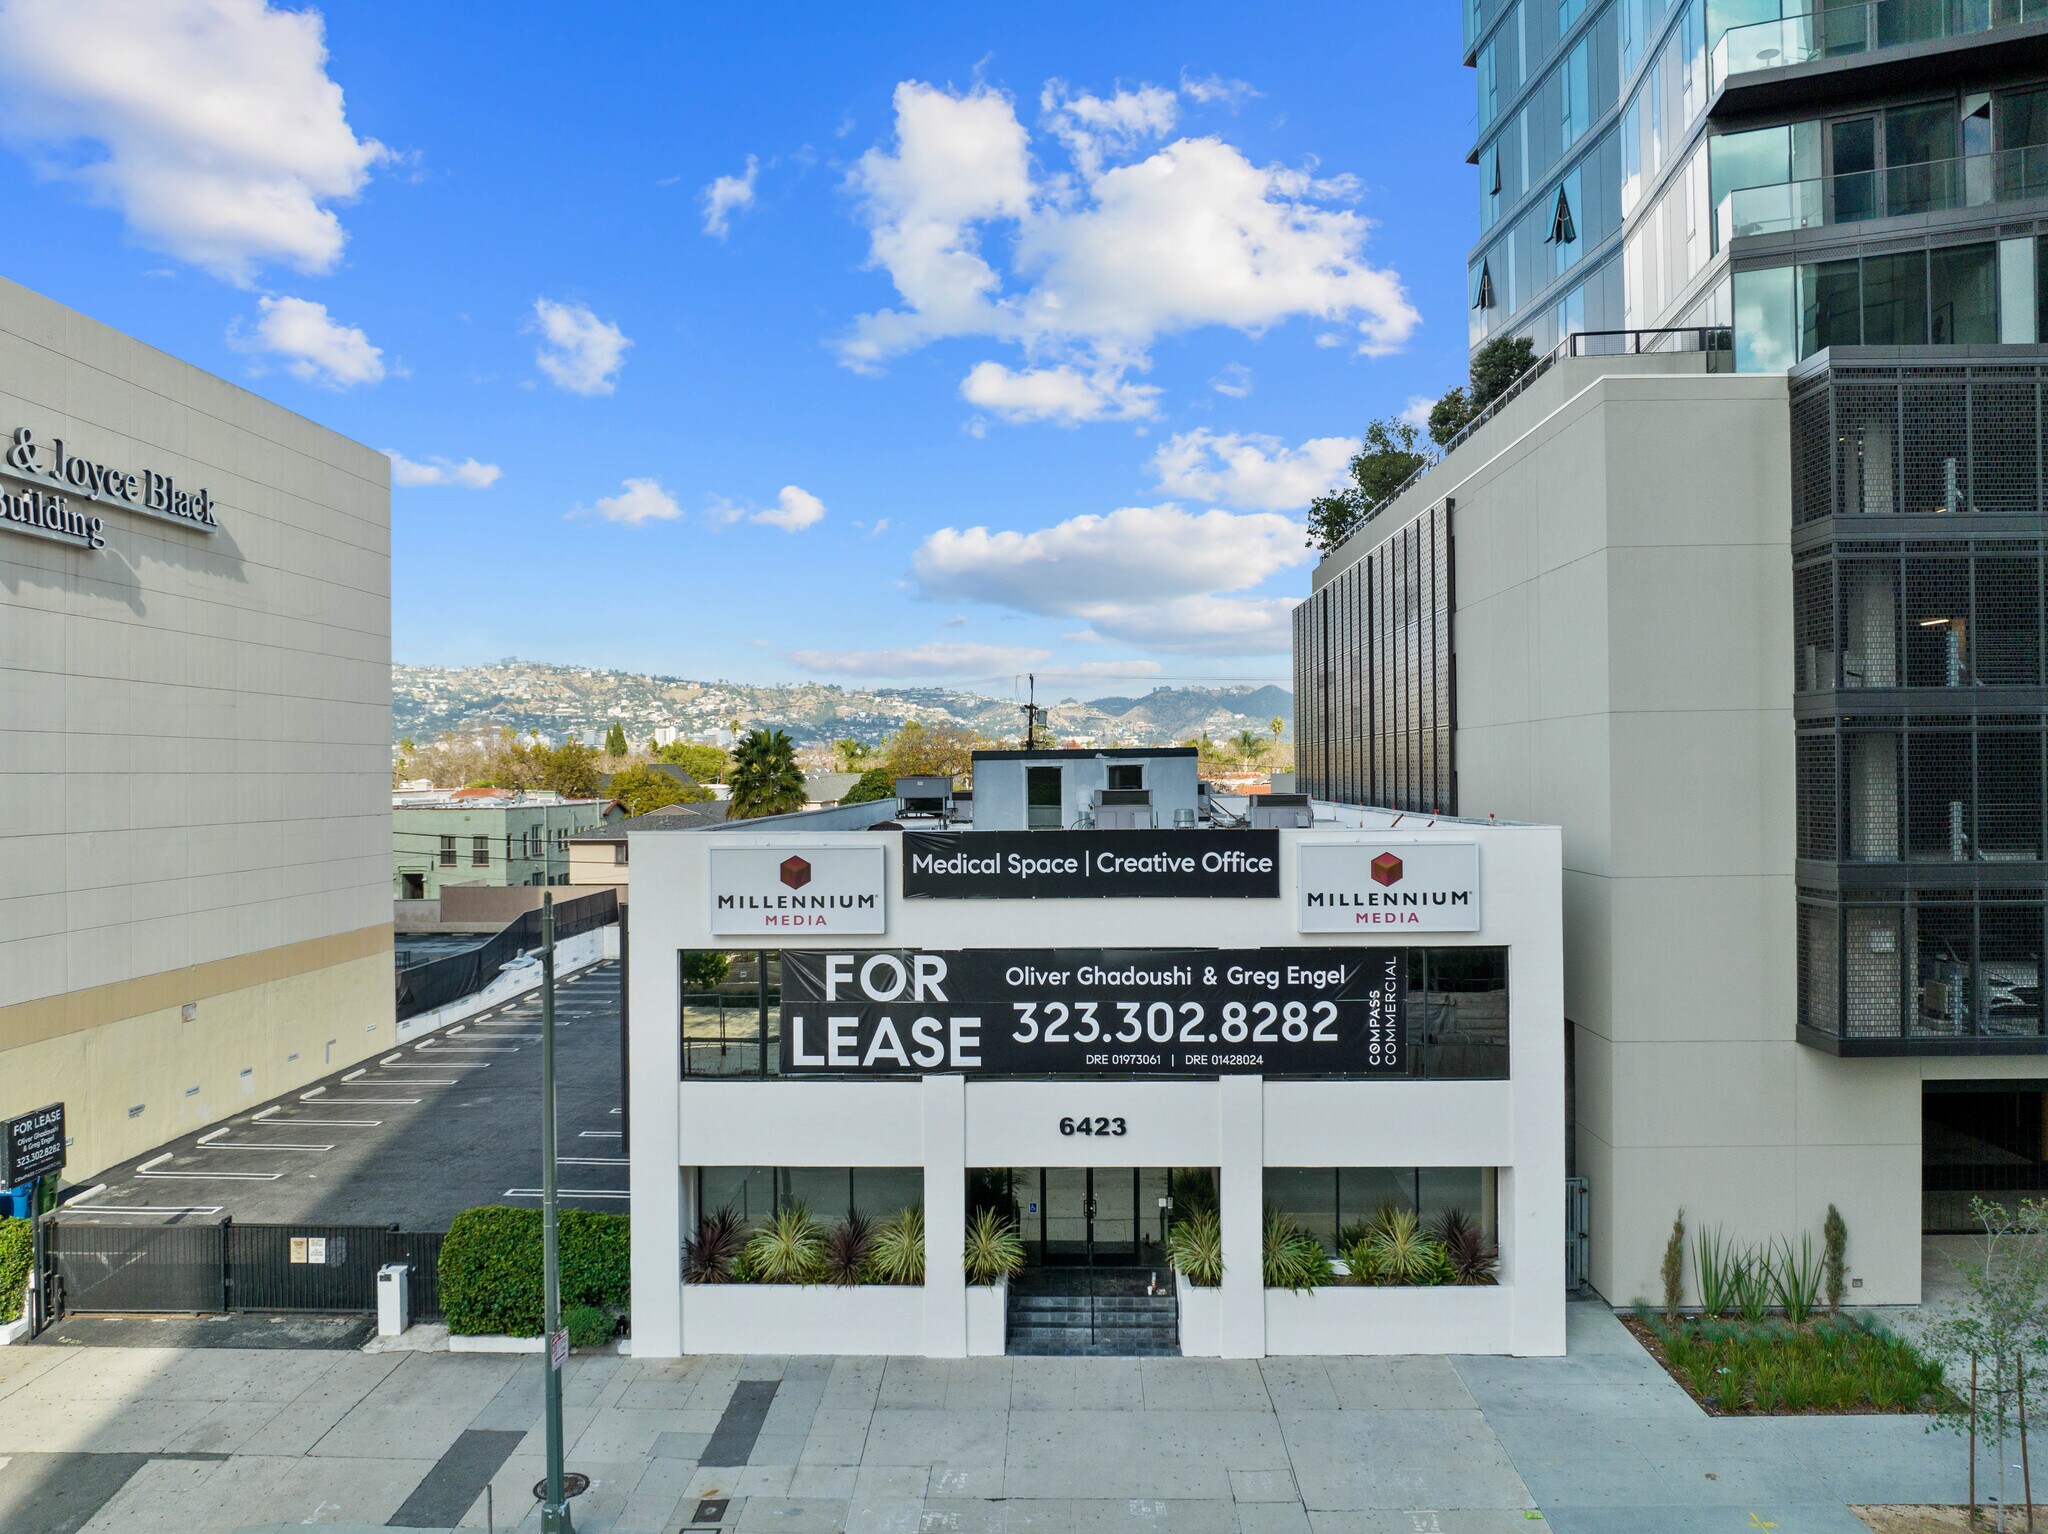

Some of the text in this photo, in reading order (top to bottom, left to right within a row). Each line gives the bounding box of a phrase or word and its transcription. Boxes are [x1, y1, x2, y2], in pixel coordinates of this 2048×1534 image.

[6, 427, 218, 526] & Joyce Black
[912, 852, 1000, 874] Medical
[1008, 853, 1078, 879] Space
[1096, 851, 1195, 873] Creative
[1201, 851, 1273, 873] Office
[765, 915, 827, 926] MEDIA
[1356, 912, 1420, 924] MEDIA
[825, 954, 949, 1002] FOR
[1005, 965, 1345, 990] Oliver Ghadoushi & Greg Engel
[1012, 1001, 1338, 1043] 323.302.8282
[1385, 956, 1396, 1065] COMMERCIAL
[1369, 990, 1380, 1065] COMPASS
[792, 1016, 982, 1068] LEASE
[1086, 1055, 1109, 1065] DRE
[1112, 1055, 1161, 1065] 01973061
[1185, 1055, 1208, 1065] DRE
[1211, 1055, 1264, 1065] 01428024
[13, 1109, 61, 1136] FOR LEASE
[1059, 1117, 1127, 1136] 6423
[17, 1136, 33, 1146] Oliver
[28, 1141, 41, 1150] Greg
[40, 1134, 55, 1145] Engel
[16, 1142, 61, 1168] 323.302.8282
